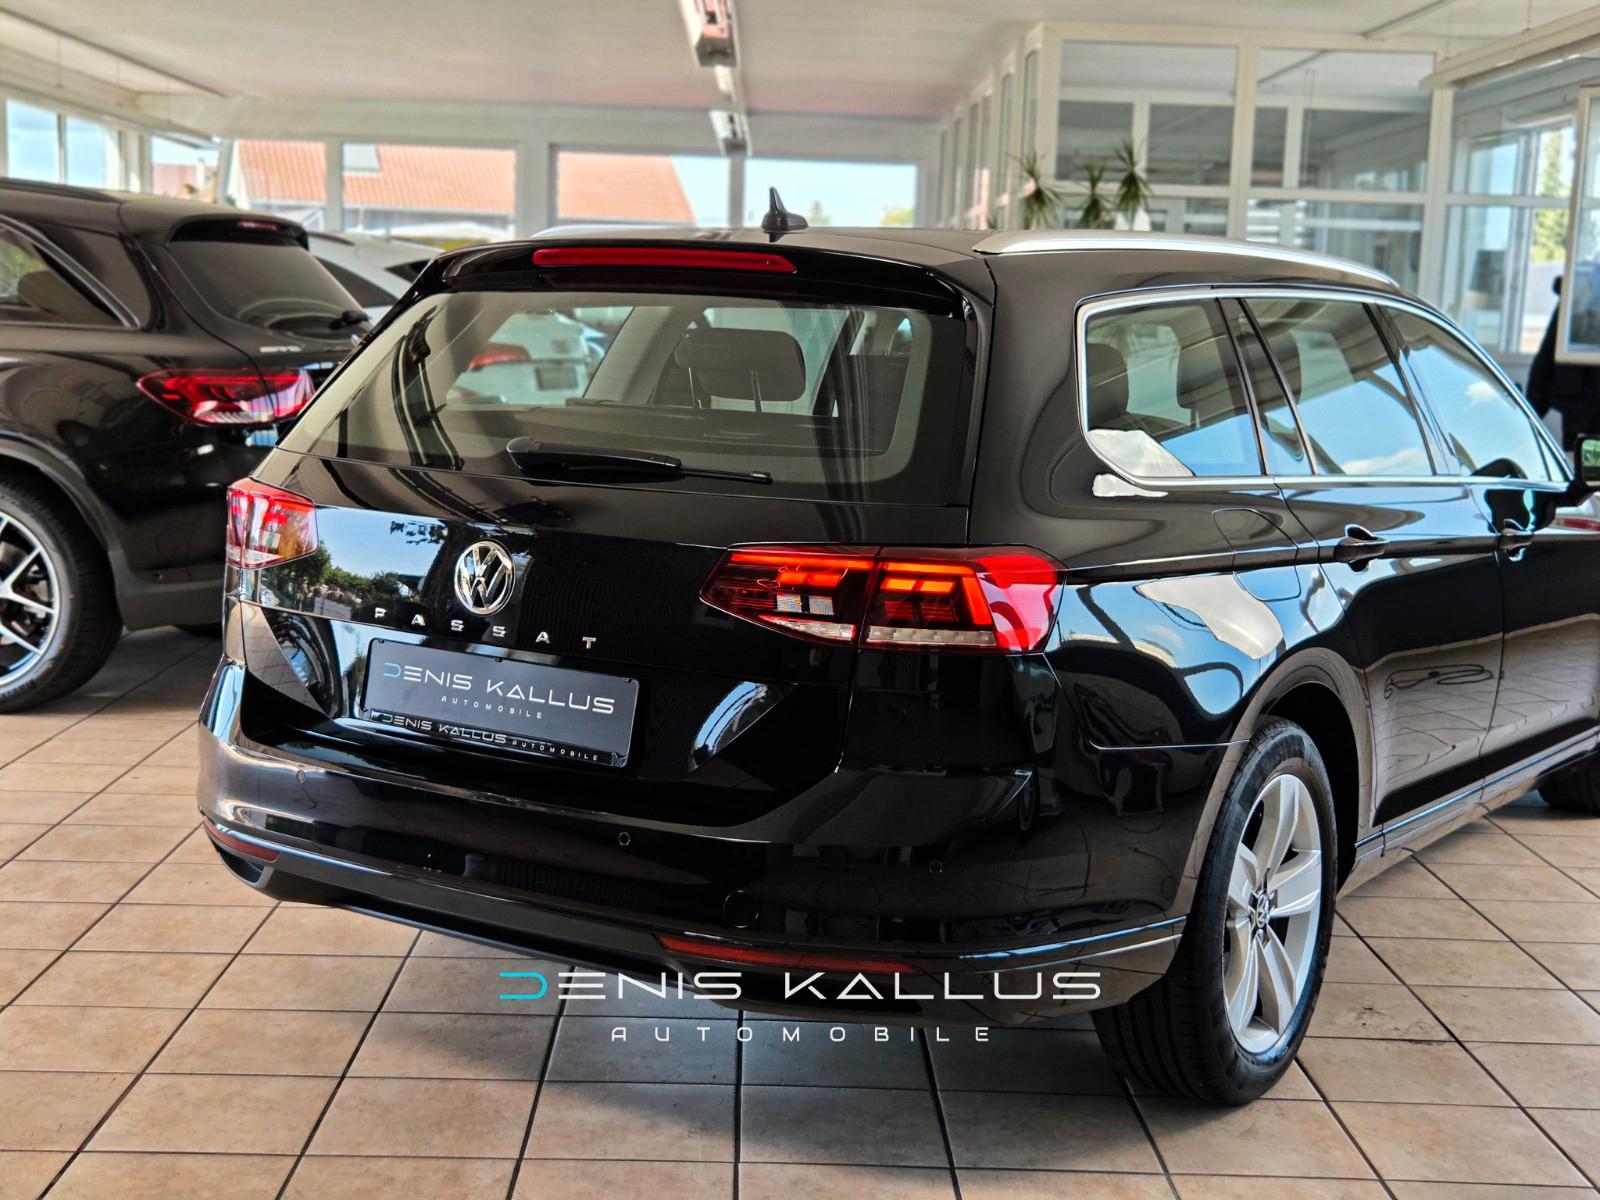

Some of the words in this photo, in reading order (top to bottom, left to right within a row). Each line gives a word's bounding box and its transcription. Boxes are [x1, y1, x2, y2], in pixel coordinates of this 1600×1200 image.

[375, 607, 596, 650] PASSAT
[384, 662, 472, 691] DENIS
[487, 679, 615, 715] KALLUS
[441, 696, 543, 720] AUTOMOBILE
[381, 715, 432, 731] DENIS
[438, 723, 507, 744] KALLUS
[512, 739, 599, 761] AUTOMOBILE
